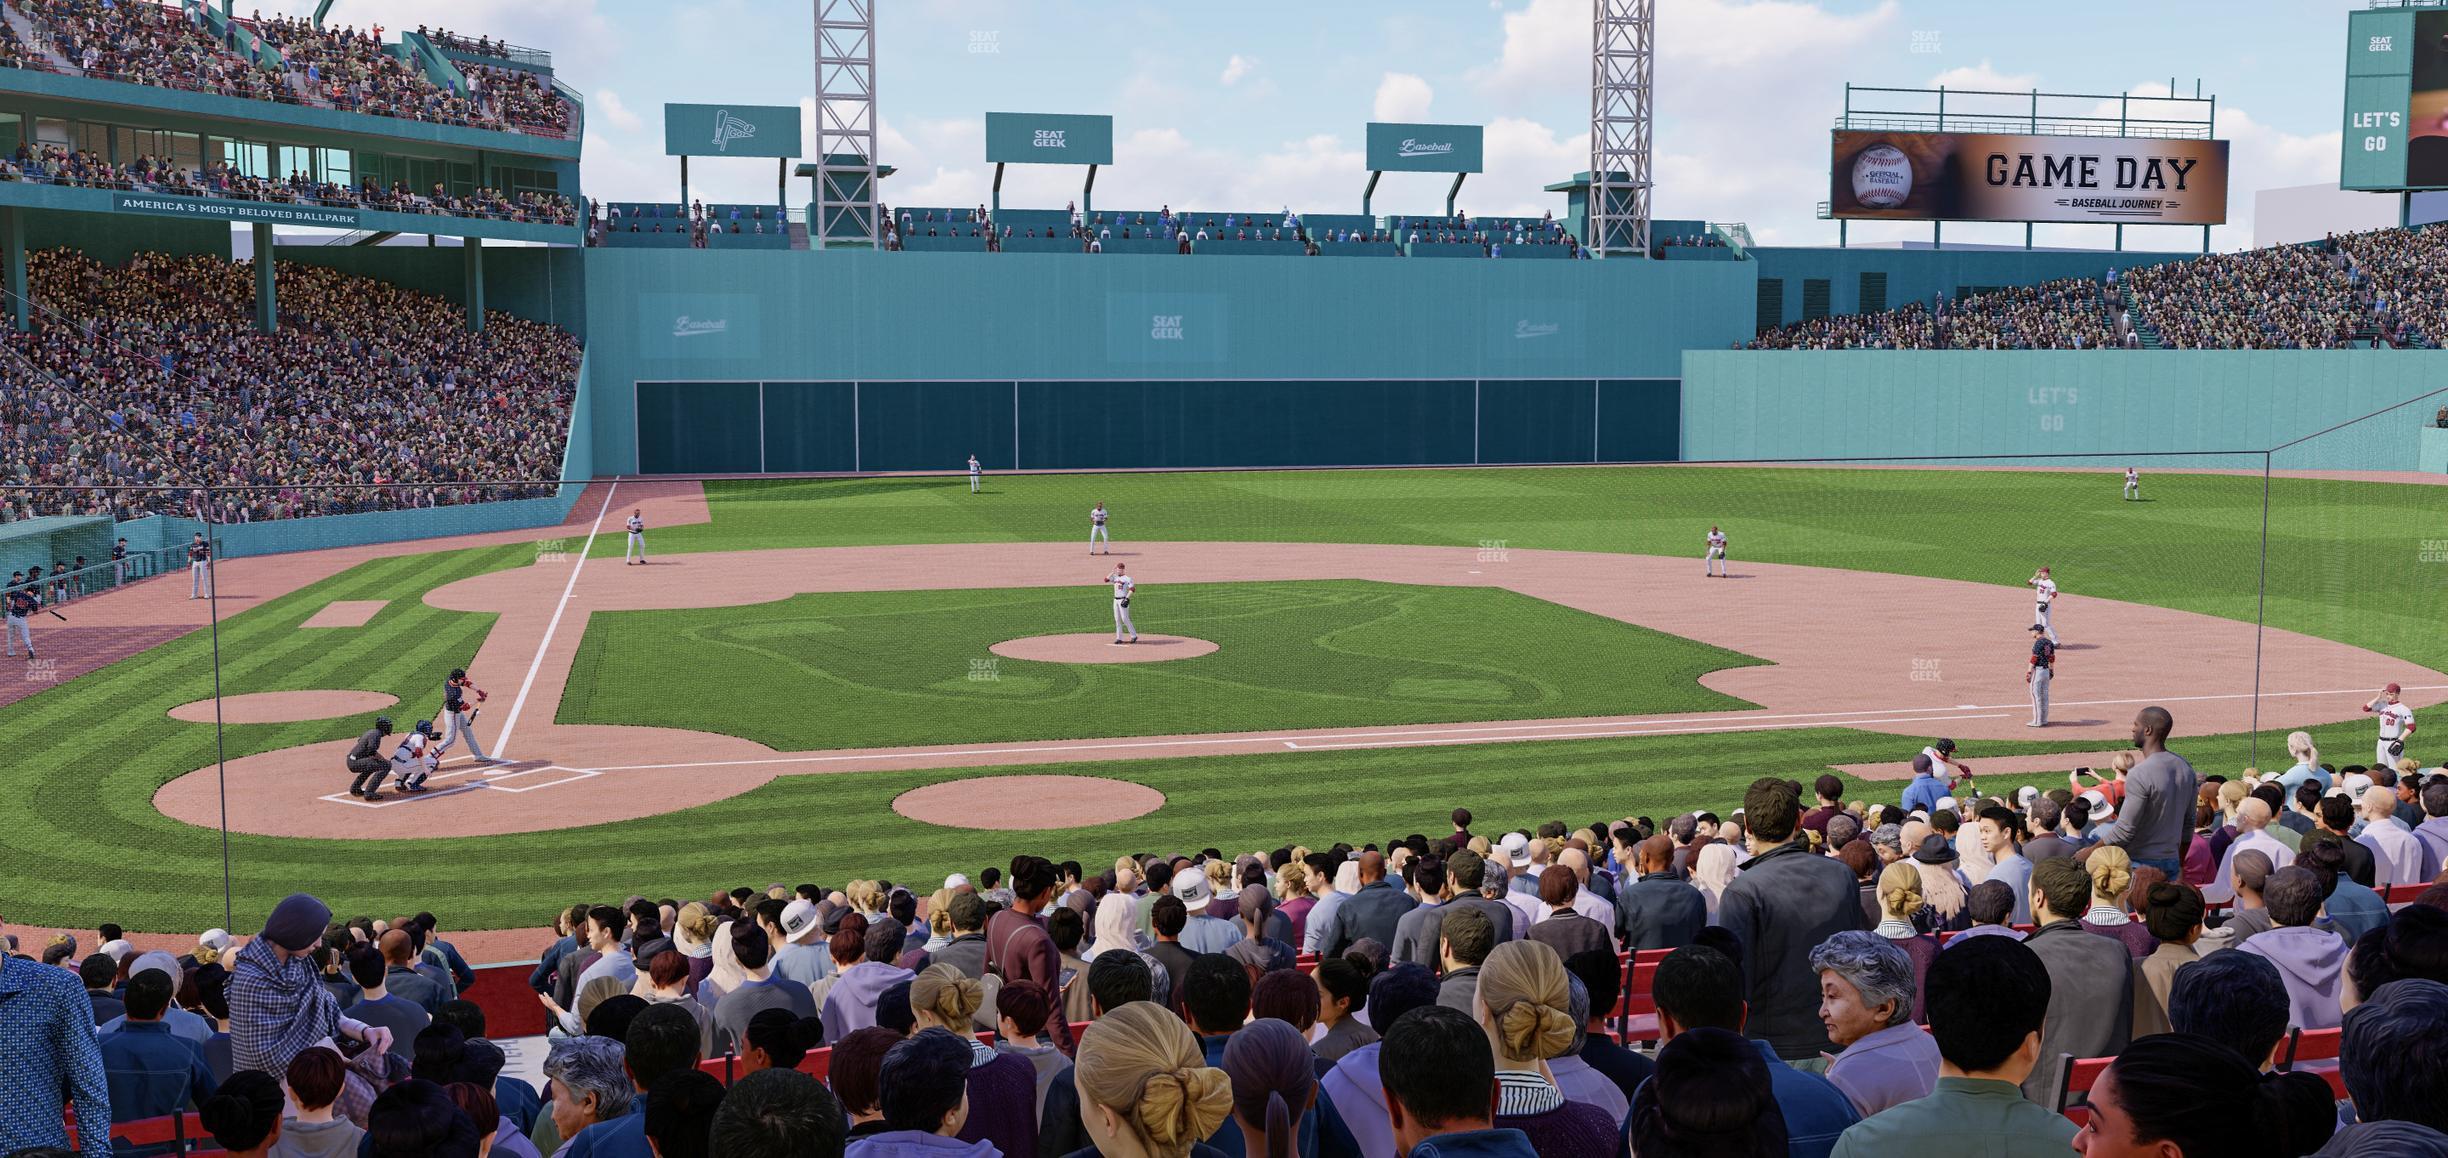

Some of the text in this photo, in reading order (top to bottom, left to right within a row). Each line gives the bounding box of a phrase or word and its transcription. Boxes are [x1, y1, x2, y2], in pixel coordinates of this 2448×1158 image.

[2370, 36, 2392, 44] SEAT
[2369, 44, 2392, 52] GEEK
[2353, 112, 2400, 128] LET'S
[1035, 130, 1065, 139] SEAT
[1033, 139, 1066, 148] GEEK
[1399, 138, 1454, 154] Baseball
[2364, 136, 2386, 151] GO
[1986, 152, 2198, 192] GAME DAY
[2071, 198, 2163, 209] BASEBALL JOURNEY
[122, 199, 355, 223] AMERICA'S MOST BELOVED BALLPARK
[1153, 315, 1183, 327] SEAT
[1152, 328, 1184, 340] GEEK
[2029, 387, 2078, 405] LET'S
[2041, 414, 2064, 432] GO
